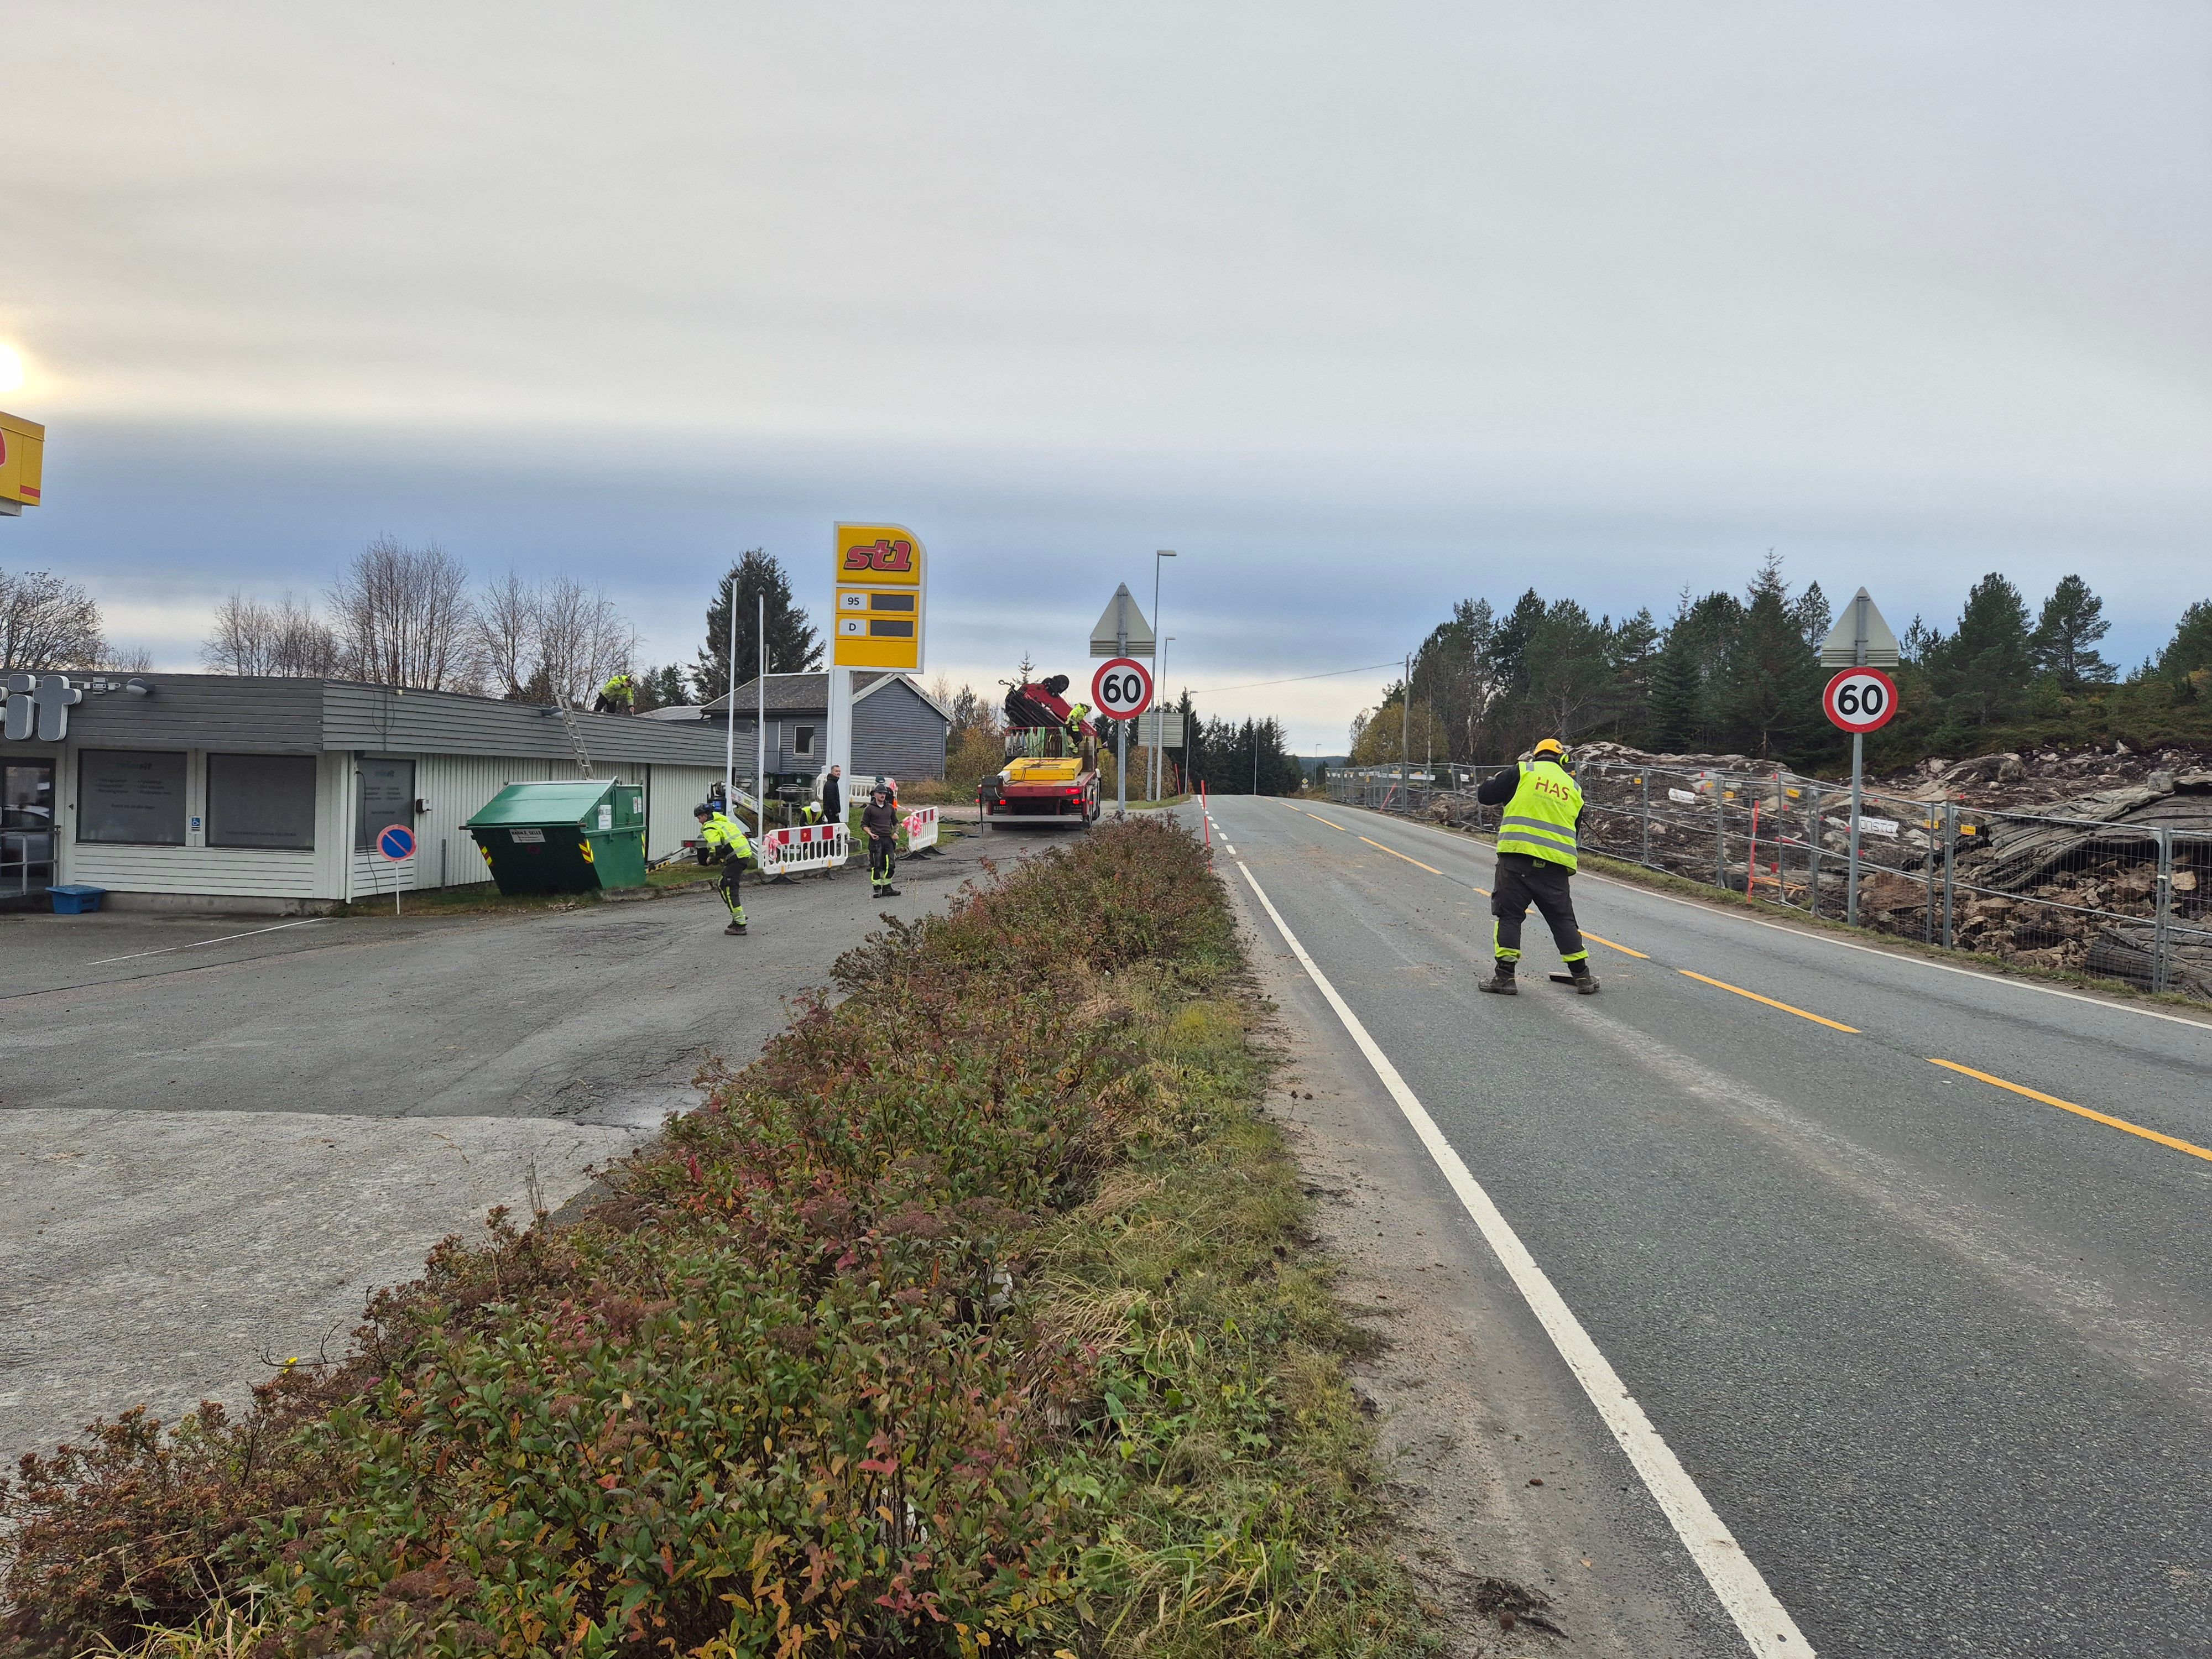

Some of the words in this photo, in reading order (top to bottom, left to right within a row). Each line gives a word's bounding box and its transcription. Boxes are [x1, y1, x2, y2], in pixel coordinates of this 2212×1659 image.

[847, 597, 859, 606] 95
[1103, 674, 1141, 703] 60
[1838, 684, 1883, 715] 60
[0, 674, 82, 741] it
[1535, 776, 1570, 801] HAS
